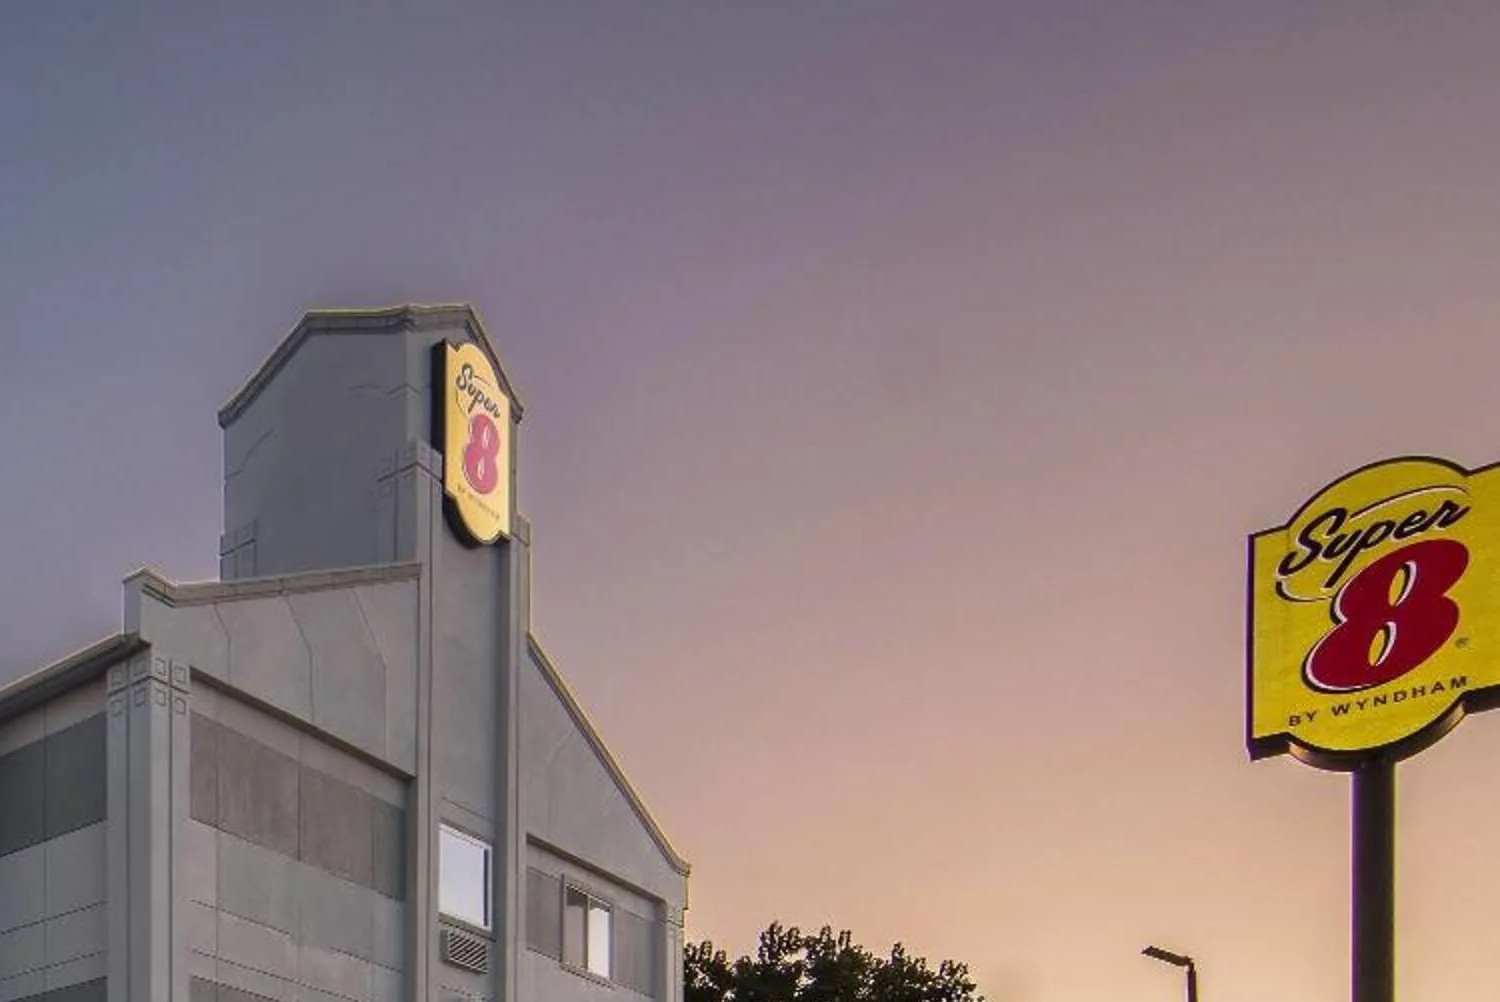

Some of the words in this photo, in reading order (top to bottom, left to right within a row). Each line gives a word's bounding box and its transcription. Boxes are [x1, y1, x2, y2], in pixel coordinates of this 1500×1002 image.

[456, 363, 501, 419] Super
[462, 413, 501, 495] 8
[1275, 499, 1472, 590] Super
[1301, 538, 1470, 695] 8
[1288, 710, 1318, 727] BY
[1331, 675, 1468, 717] WYNDHAM
